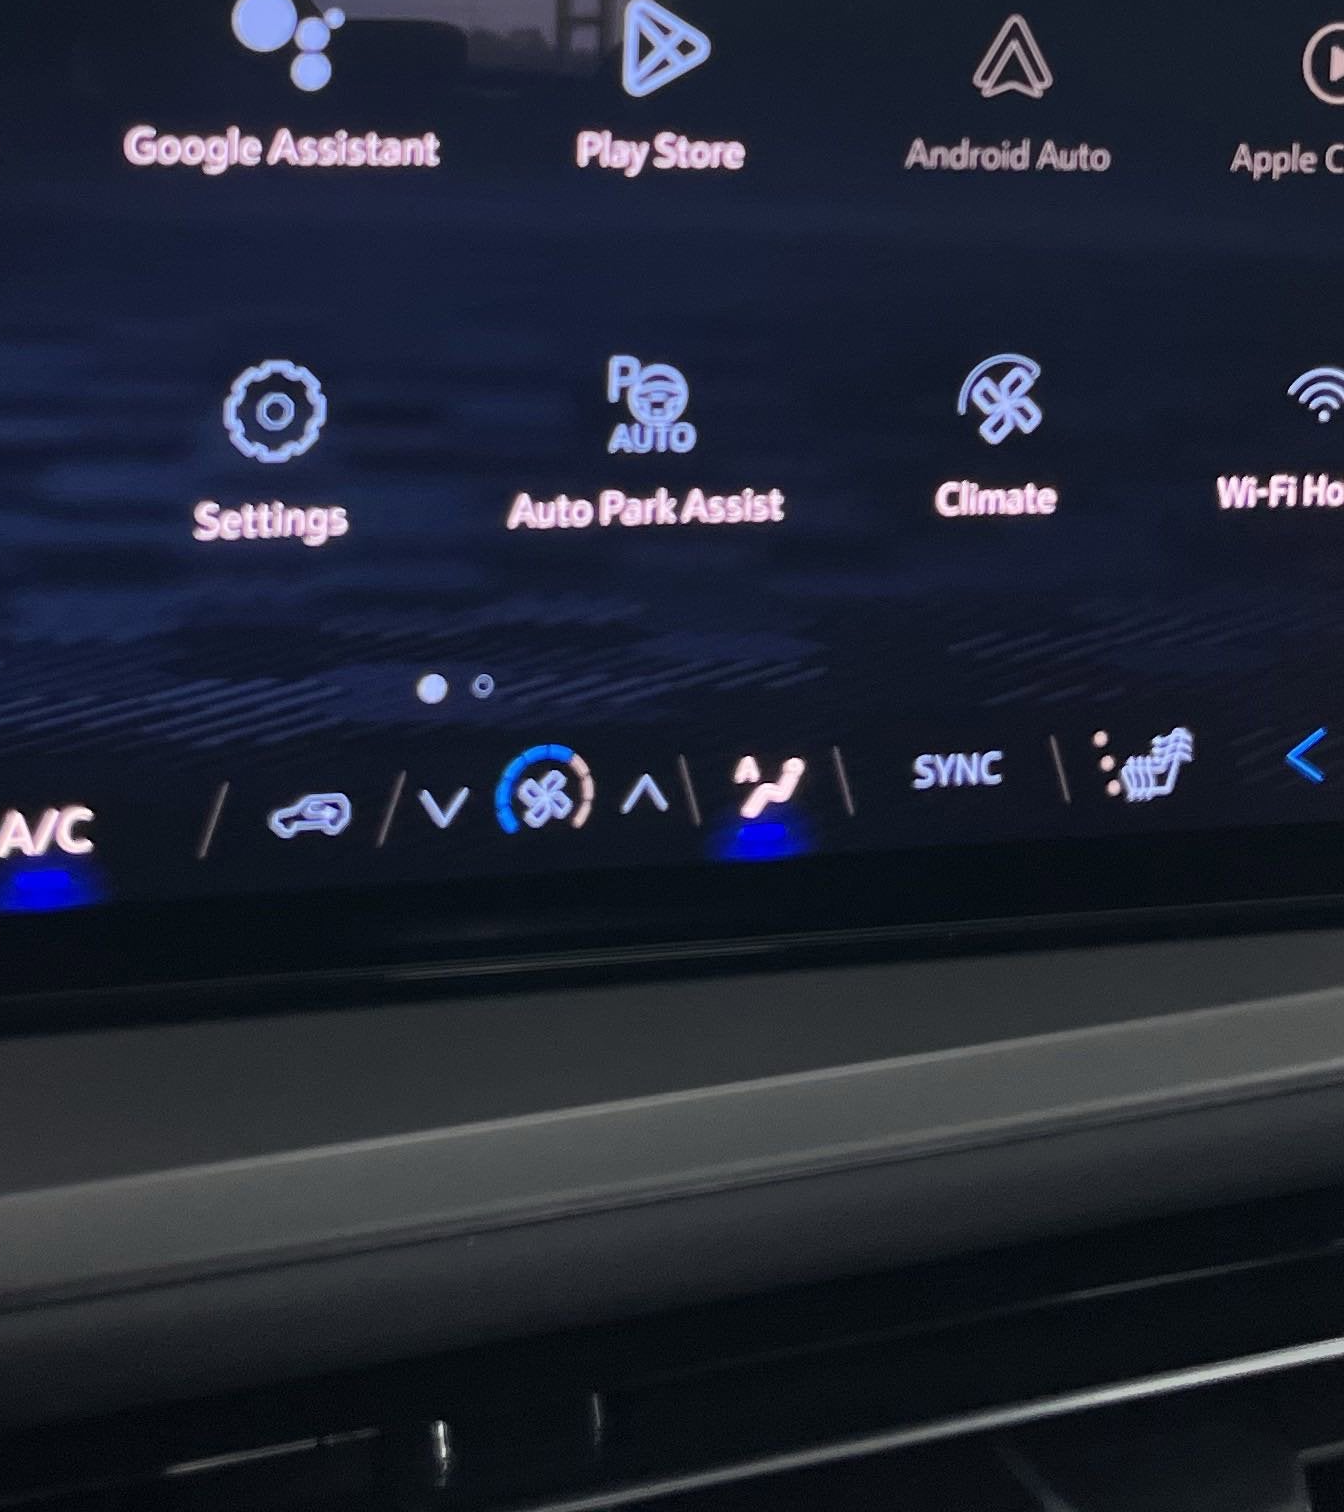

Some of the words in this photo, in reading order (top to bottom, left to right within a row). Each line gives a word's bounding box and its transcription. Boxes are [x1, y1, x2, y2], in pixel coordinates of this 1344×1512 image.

[123, 125, 263, 175] Google
[267, 127, 441, 168] Assistant
[576, 130, 650, 178] Play
[652, 131, 746, 170] Store
[904, 137, 1030, 171] Android
[1035, 139, 1112, 172] Auto
[1229, 142, 1318, 181] Apple
[607, 422, 698, 454] AUTO
[507, 492, 594, 530] Auto
[598, 486, 678, 527] Park
[680, 487, 785, 524] Assist
[934, 479, 1058, 517] Climate
[1216, 473, 1298, 509] Wi-Fi
[193, 501, 349, 546] Settings
[913, 750, 1003, 789] SYNC
